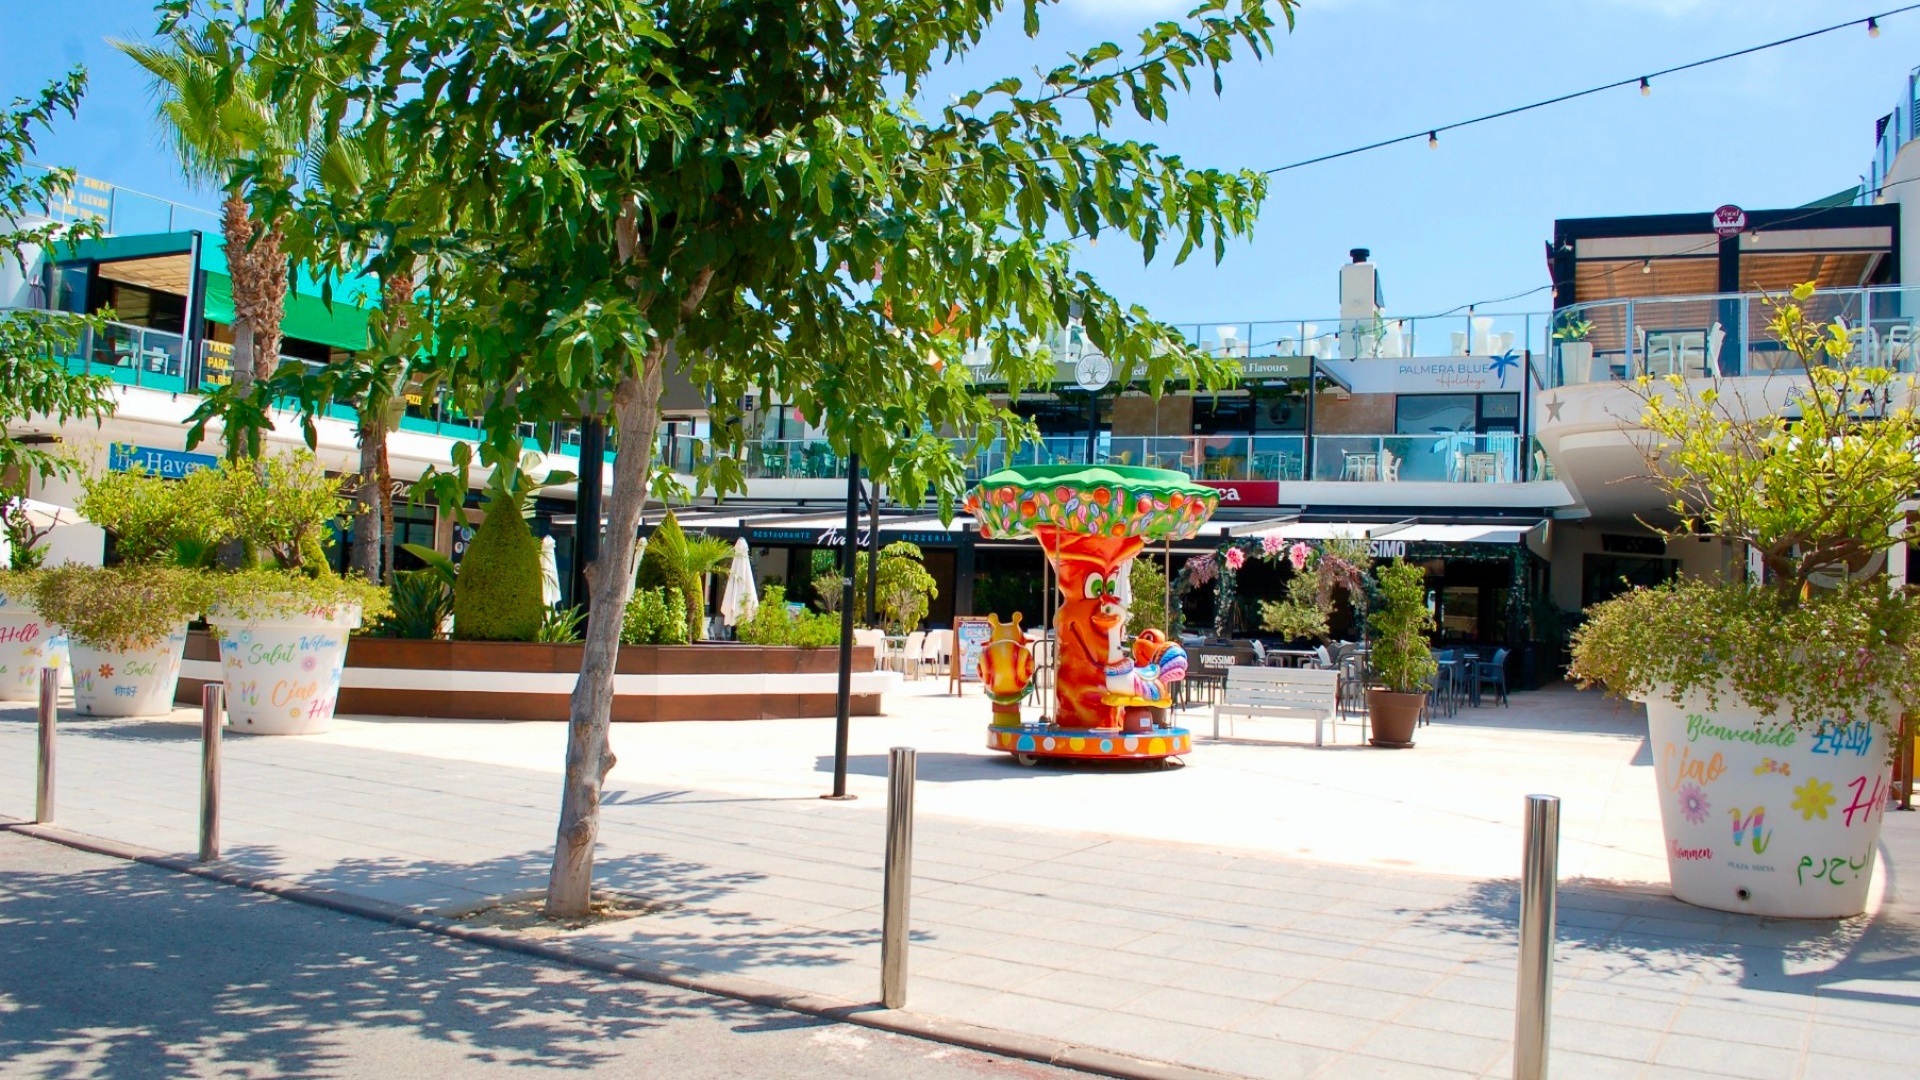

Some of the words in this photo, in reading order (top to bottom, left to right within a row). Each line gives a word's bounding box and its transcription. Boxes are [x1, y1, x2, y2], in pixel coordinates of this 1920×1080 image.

[208, 340, 232, 355] TAKE
[206, 356, 229, 370] PARA
[1249, 362, 1289, 374] Flavours
[1400, 364, 1454, 374] PALMERA
[1458, 363, 1490, 373] BLUE
[753, 530, 810, 540] RESTAURANTE
[902, 534, 952, 542] PIZZERIA
[0, 623, 39, 643] Hello
[248, 643, 296, 666] Salut
[1200, 654, 1236, 665] VINISSIMO
[272, 678, 318, 708] Ciao
[1686, 714, 1797, 747] Bienvenido
[1662, 742, 1727, 793] Ciao
